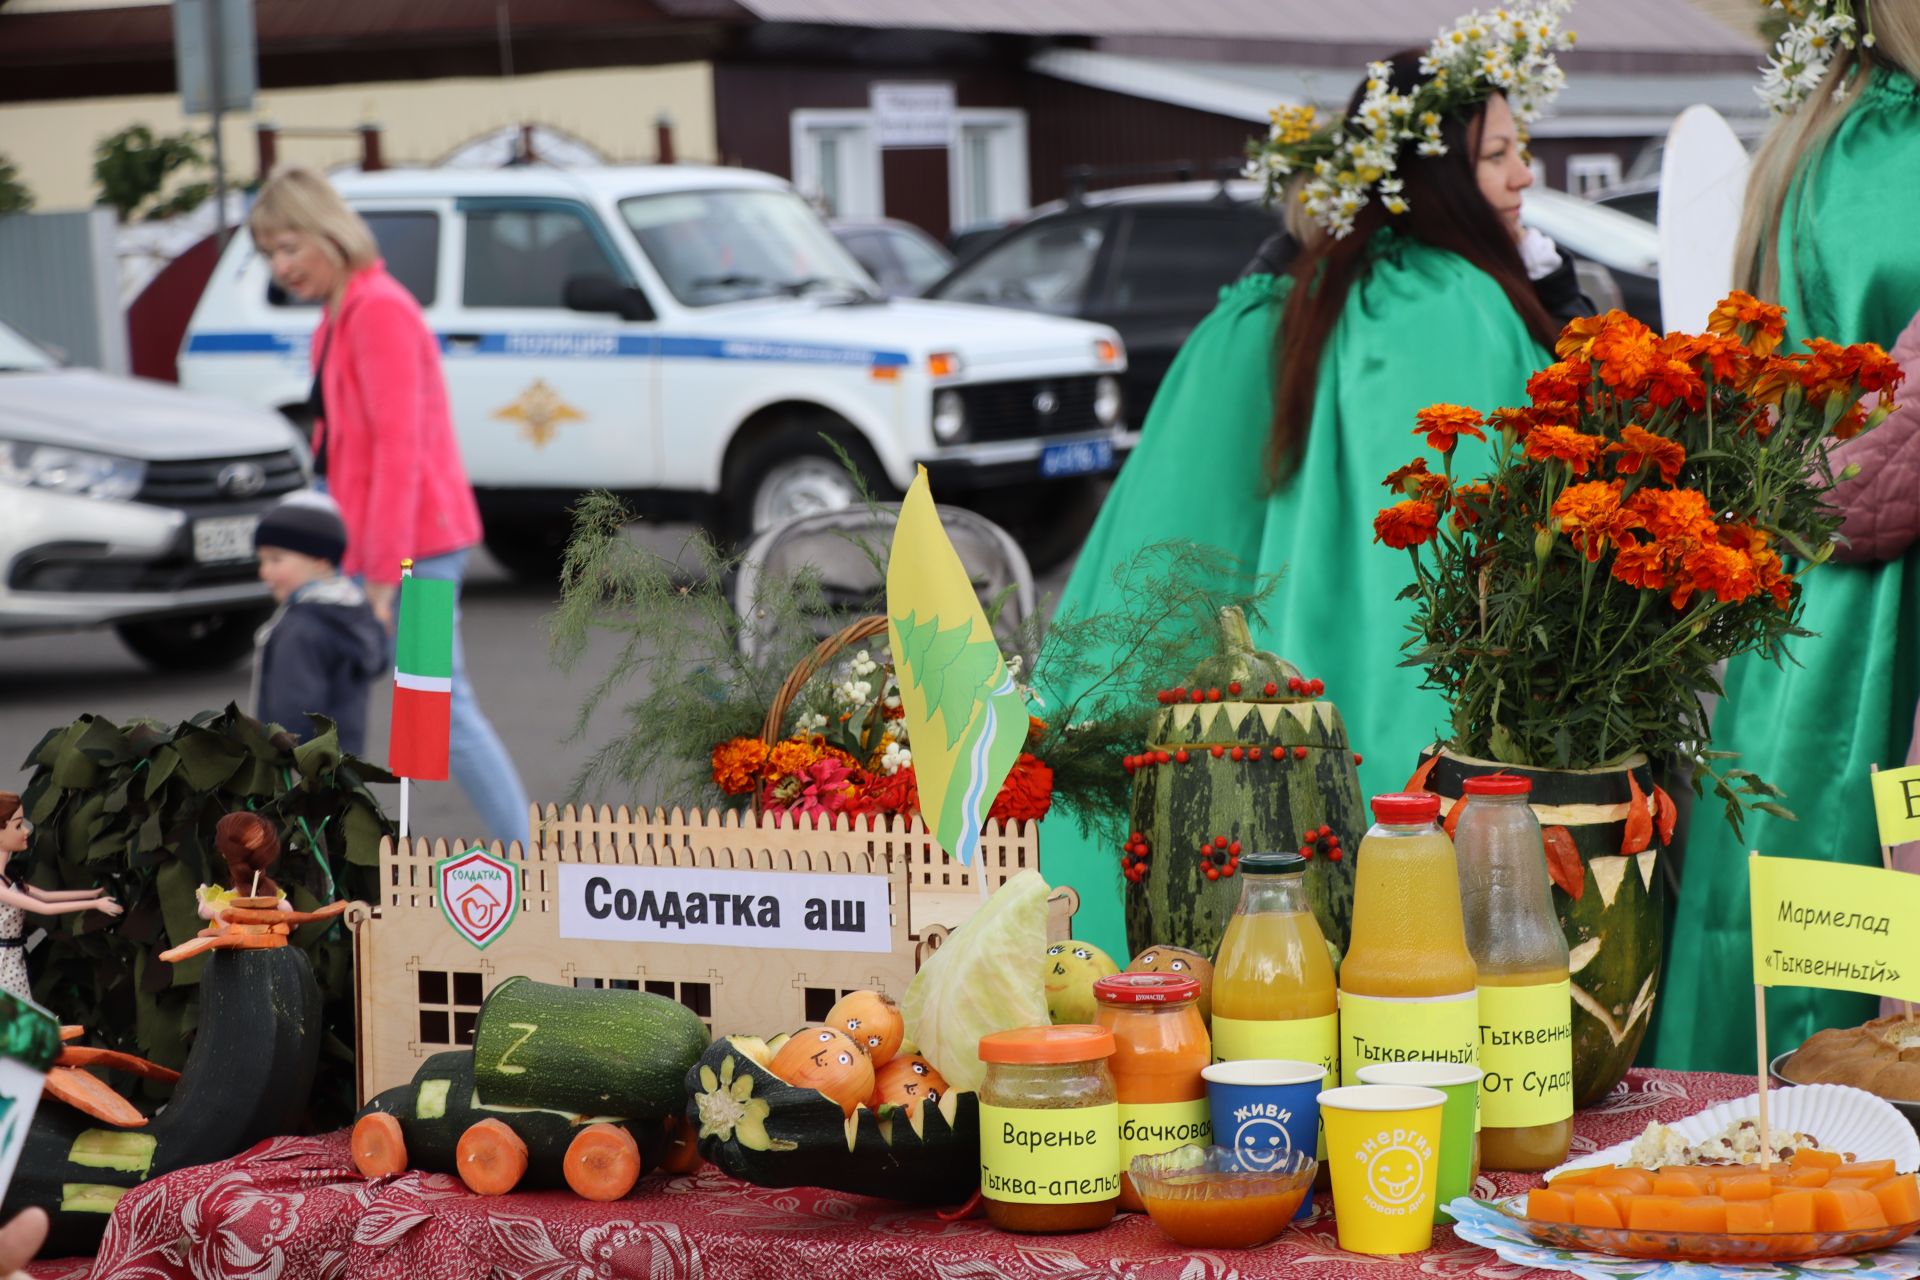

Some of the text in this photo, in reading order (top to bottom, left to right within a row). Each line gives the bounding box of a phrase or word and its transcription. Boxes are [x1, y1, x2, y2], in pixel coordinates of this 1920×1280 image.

[452, 870, 501, 882] СОЛДАТКА
[584, 876, 866, 933] Солдатка аш
[1778, 900, 1890, 936] Мармелад
[1765, 950, 1900, 983] «Тыквенный»
[497, 1022, 539, 1074] Z
[1353, 1036, 1473, 1064] Тыквенный
[1483, 1072, 1513, 1093] От
[1233, 1103, 1292, 1123] ЖИВИ
[1003, 1122, 1097, 1153] Варенье
[1118, 1119, 1211, 1141] бачковая
[1355, 1128, 1432, 1164] энергия
